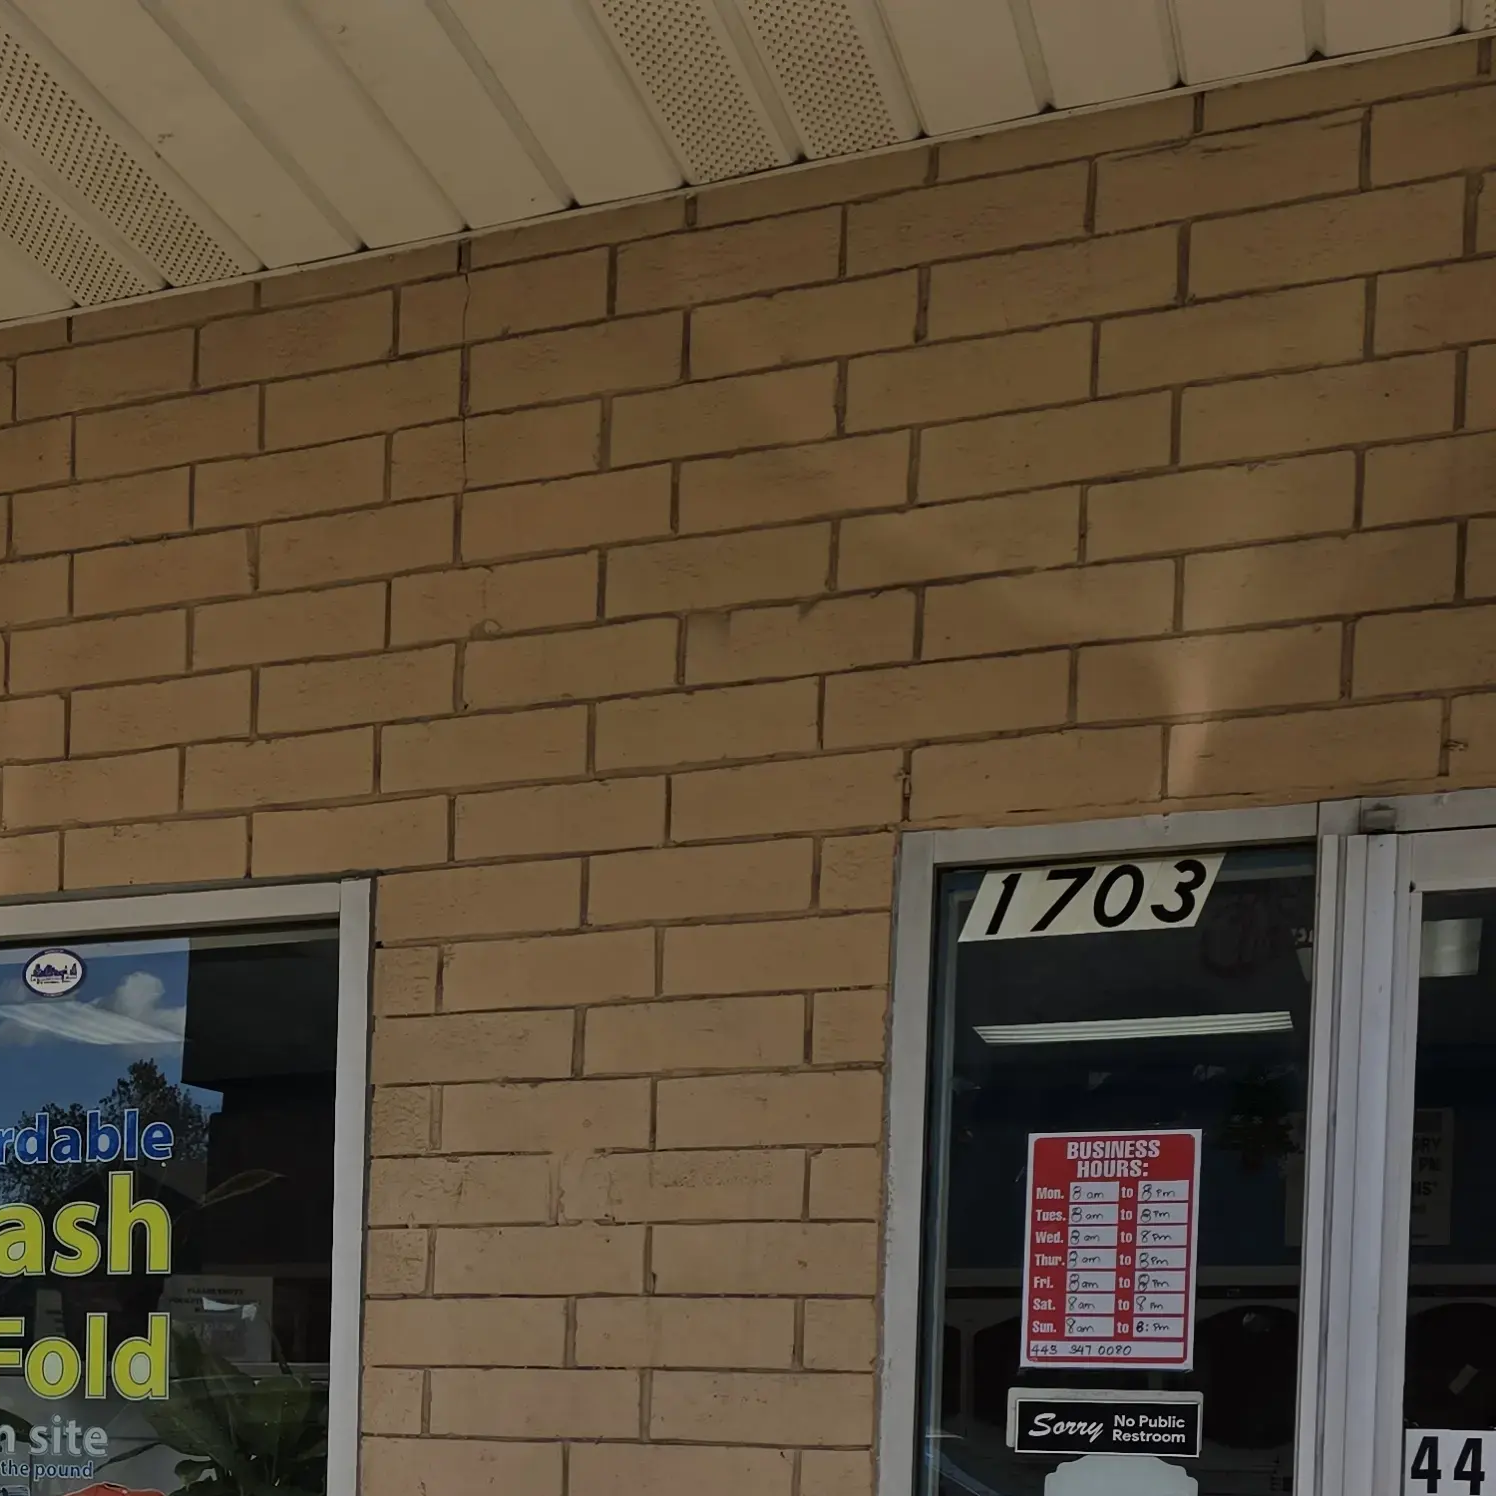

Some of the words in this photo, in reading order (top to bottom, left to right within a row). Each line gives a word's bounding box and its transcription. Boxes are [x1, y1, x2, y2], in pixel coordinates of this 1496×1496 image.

[985, 859, 1207, 937] 1703
[1066, 1139, 1161, 1160] BUSINESS
[1077, 1159, 1149, 1178] HOURS:
[1036, 1187, 1065, 1200] Mon.
[1121, 1186, 1134, 1199] to
[1035, 1209, 1066, 1222] Tues.
[1120, 1208, 1133, 1221] to
[1035, 1231, 1064, 1244] Wed.
[1120, 1230, 1133, 1243] to
[1034, 1254, 1066, 1266] Thur.
[1119, 1253, 1132, 1266] to
[1033, 1276, 1054, 1289] Fri.
[1118, 1276, 1131, 1289] to
[1032, 1298, 1056, 1311] Sat.
[1117, 1299, 1130, 1311] to
[1032, 1321, 1057, 1333] Sun.
[1117, 1321, 1130, 1334] to
[1031, 1344, 1058, 1355] 443
[1069, 1344, 1092, 1355] 347
[1028, 1412, 1104, 1443] Sorry
[1113, 1414, 1136, 1427] No
[1139, 1415, 1186, 1428] Public
[28, 1413, 109, 1456] site
[1112, 1429, 1186, 1443] Restroom
[0, 1459, 30, 1477] the
[34, 1461, 94, 1482] pound
[1410, 1436, 1486, 1496] 44
